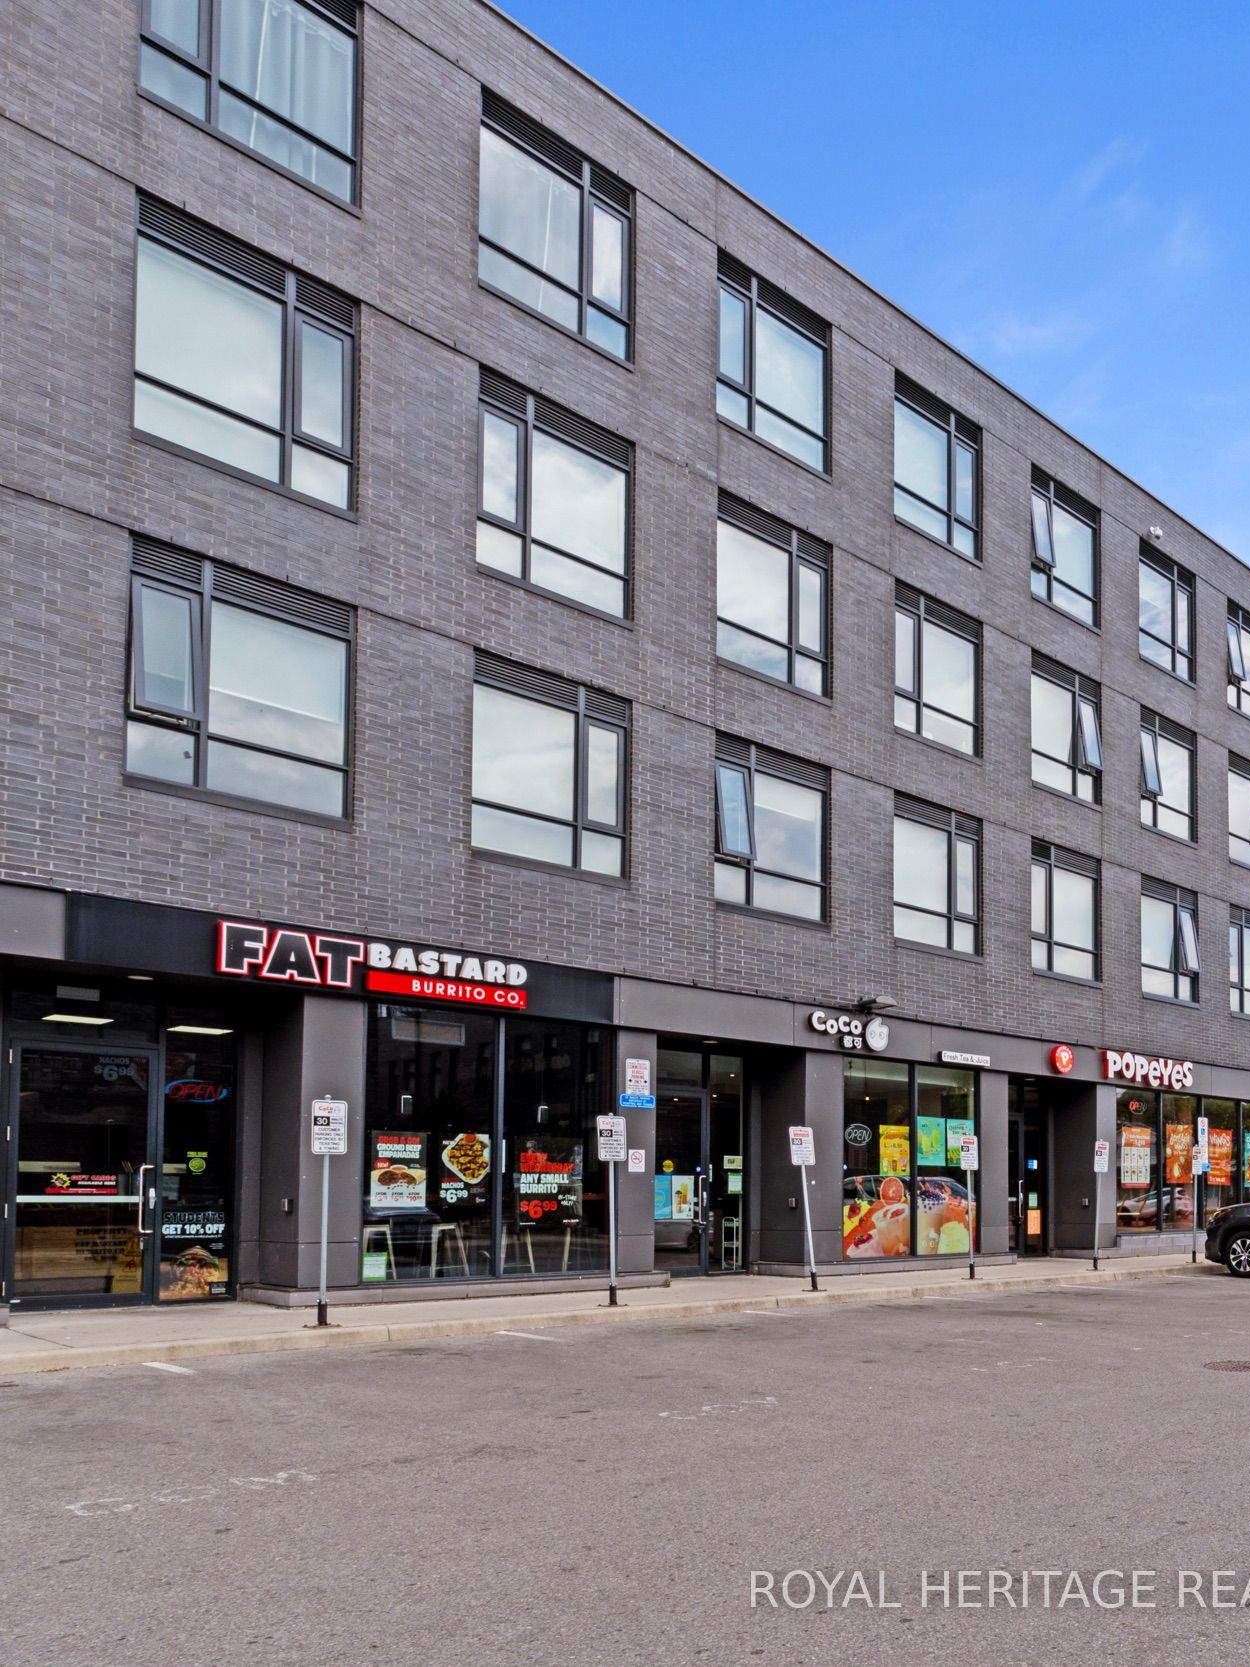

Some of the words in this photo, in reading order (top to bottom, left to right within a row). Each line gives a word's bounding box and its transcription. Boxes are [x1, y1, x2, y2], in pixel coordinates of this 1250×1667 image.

[217, 920, 365, 987] FAT
[367, 943, 528, 986] BASTARD
[411, 979, 486, 1001] BURRITO
[493, 989, 525, 1006] CO.
[810, 1010, 863, 1035] CoCo
[943, 1051, 959, 1061] Fresh
[959, 1053, 969, 1062] Tea
[975, 1056, 990, 1065] Juice
[168, 1083, 222, 1101] OPEN
[1129, 1100, 1145, 1112] OPEN
[316, 1117, 328, 1125] 30
[846, 1129, 870, 1141] OPEN
[377, 1143, 405, 1151] GROUND
[405, 1144, 422, 1152] BEEF
[378, 1151, 420, 1159] EMPANADAS
[520, 1173, 539, 1184] ANY
[540, 1173, 569, 1184] SMALL
[520, 1183, 558, 1194] BURRITO
[163, 1211, 225, 1224] STUDENTS
[162, 1223, 183, 1235] GET
[184, 1223, 205, 1235] 10%
[205, 1223, 226, 1234] OFF
